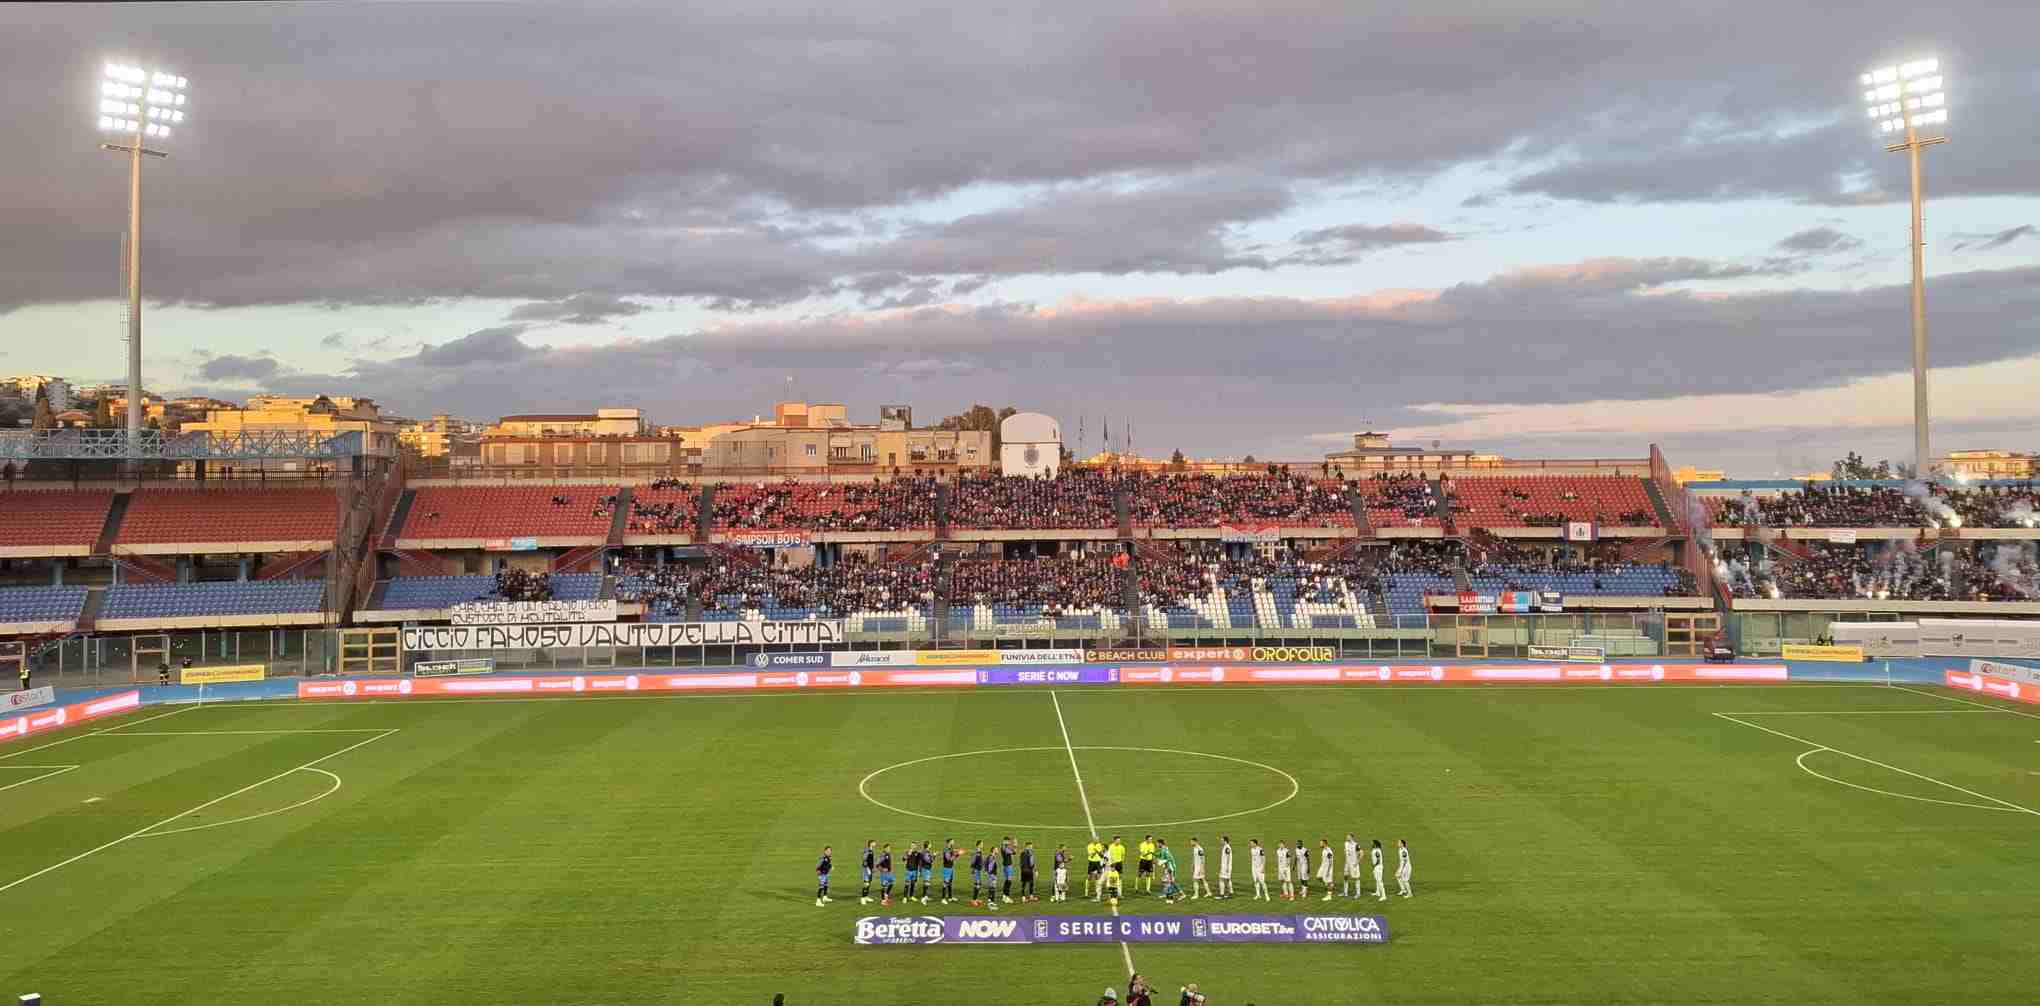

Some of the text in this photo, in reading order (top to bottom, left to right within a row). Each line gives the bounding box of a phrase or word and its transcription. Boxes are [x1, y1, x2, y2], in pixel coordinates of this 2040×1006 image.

[736, 533, 800, 545] SIMPSON BOYS
[476, 627, 572, 649] FAMOSO
[579, 624, 663, 647] VANTO
[668, 623, 753, 645] DELLA
[773, 654, 824, 665] COMER SUD
[1001, 653, 1036, 662] FUNIVIA
[1099, 651, 1166, 661] BEACH CLUB
[1173, 650, 1230, 662] expert
[1018, 671, 1080, 682] SERIE C NOW
[857, 918, 941, 939] Beretta
[958, 920, 1017, 938] NOW
[1060, 922, 1180, 935] SERIE C NOW
[1303, 917, 1380, 932] CATTOLICA
